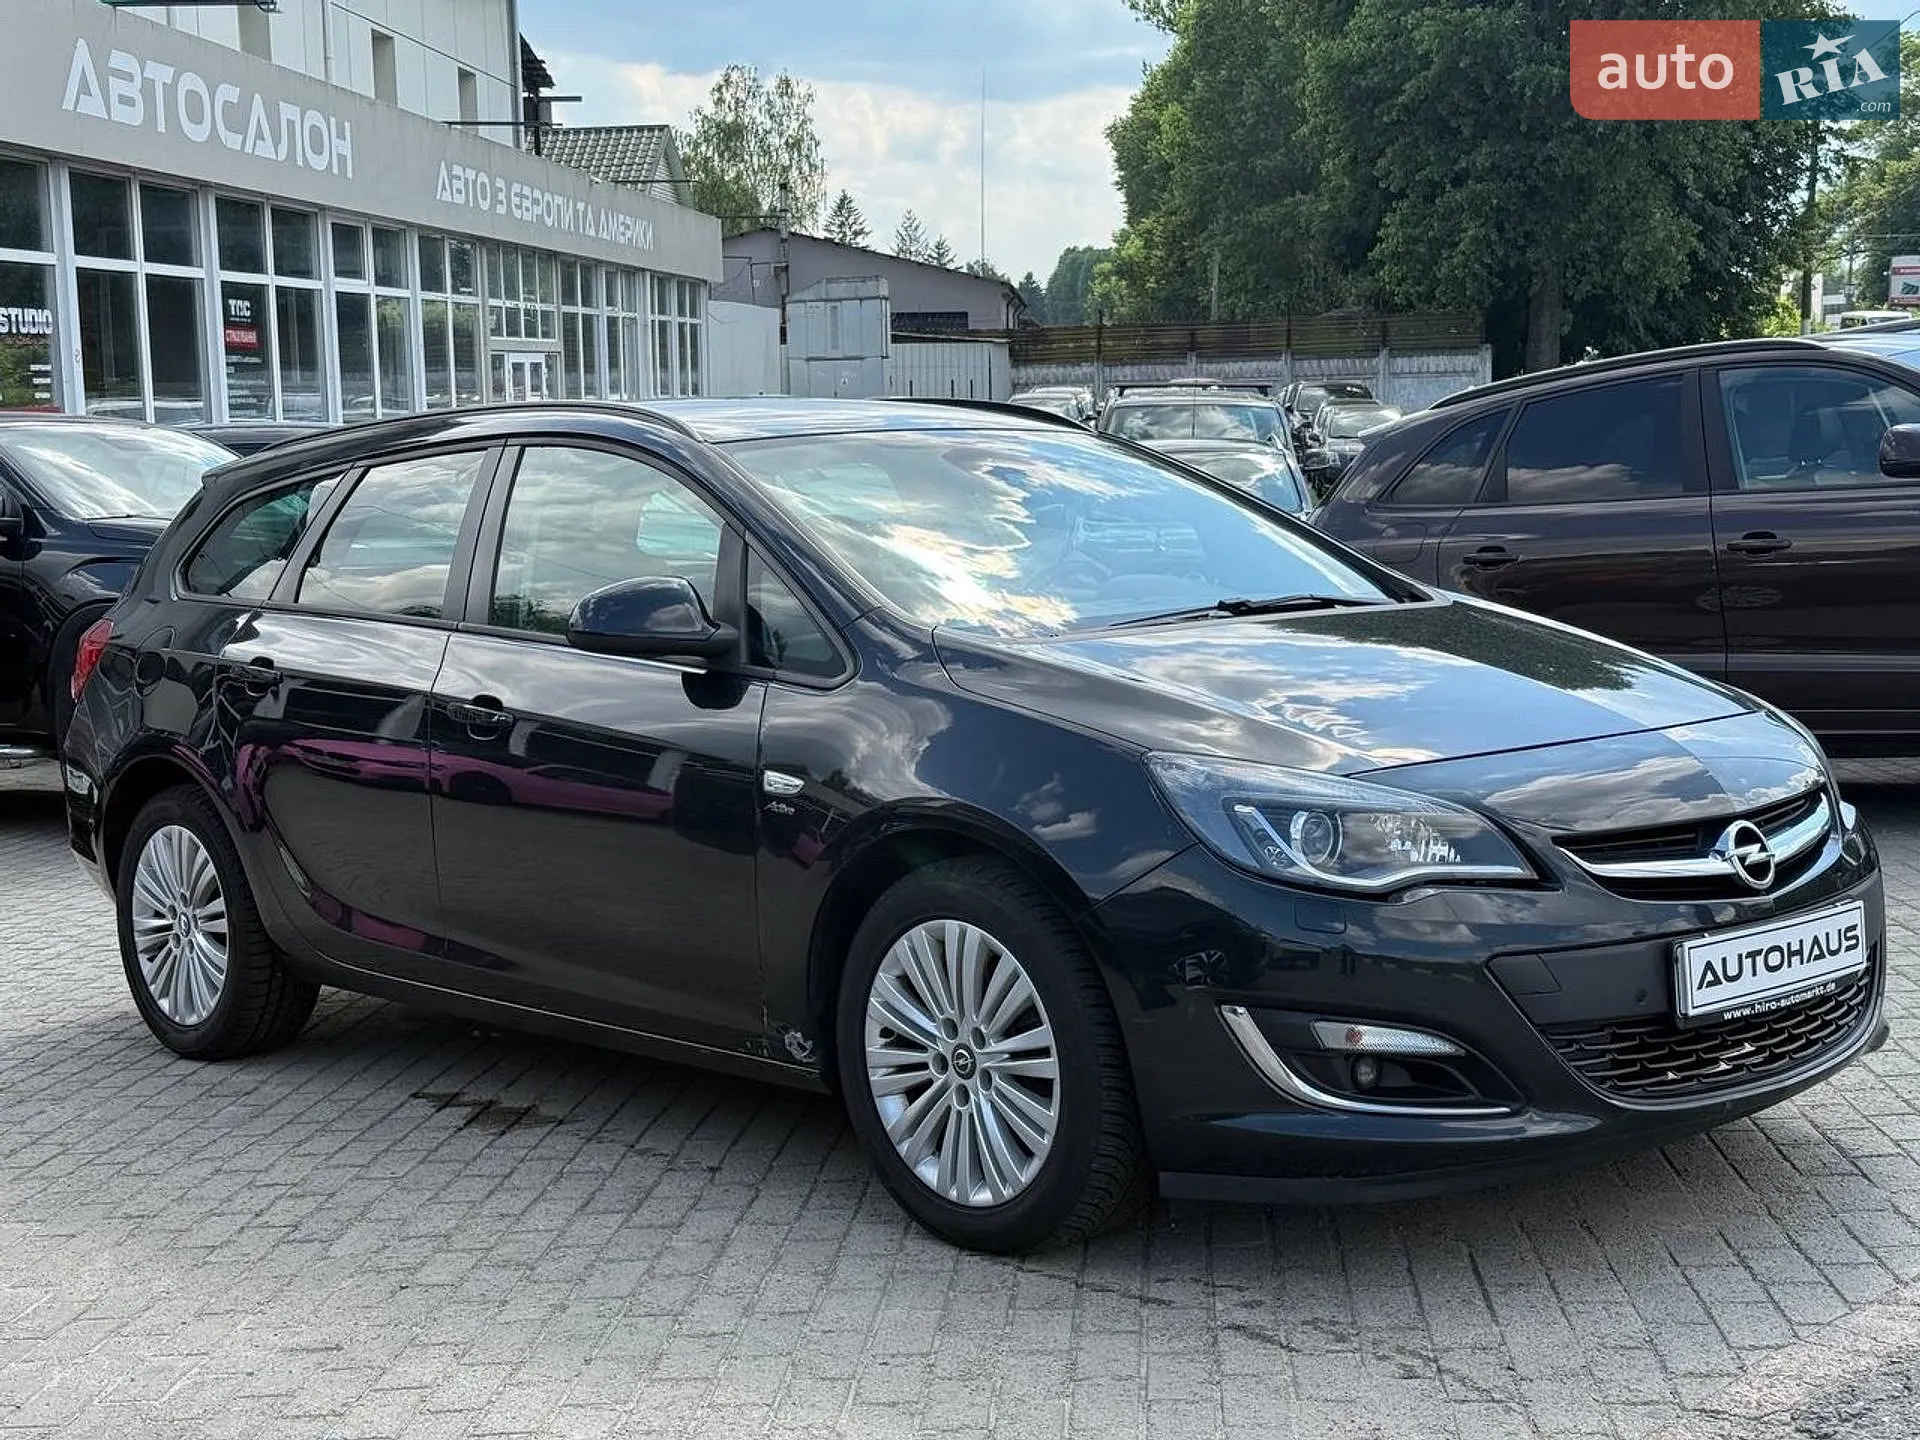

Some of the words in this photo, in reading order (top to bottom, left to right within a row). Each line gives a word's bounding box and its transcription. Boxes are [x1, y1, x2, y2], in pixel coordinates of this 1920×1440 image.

[61, 37, 353, 180] АВТОСАЛОН
[436, 160, 491, 212] АВТО
[511, 181, 574, 232] ЄВРОПИ
[577, 202, 595, 237] ТА
[598, 207, 654, 251] АМЕРИКИ
[0, 307, 53, 334] STUDIO
[1697, 923, 1860, 990] AUTOHAUS
